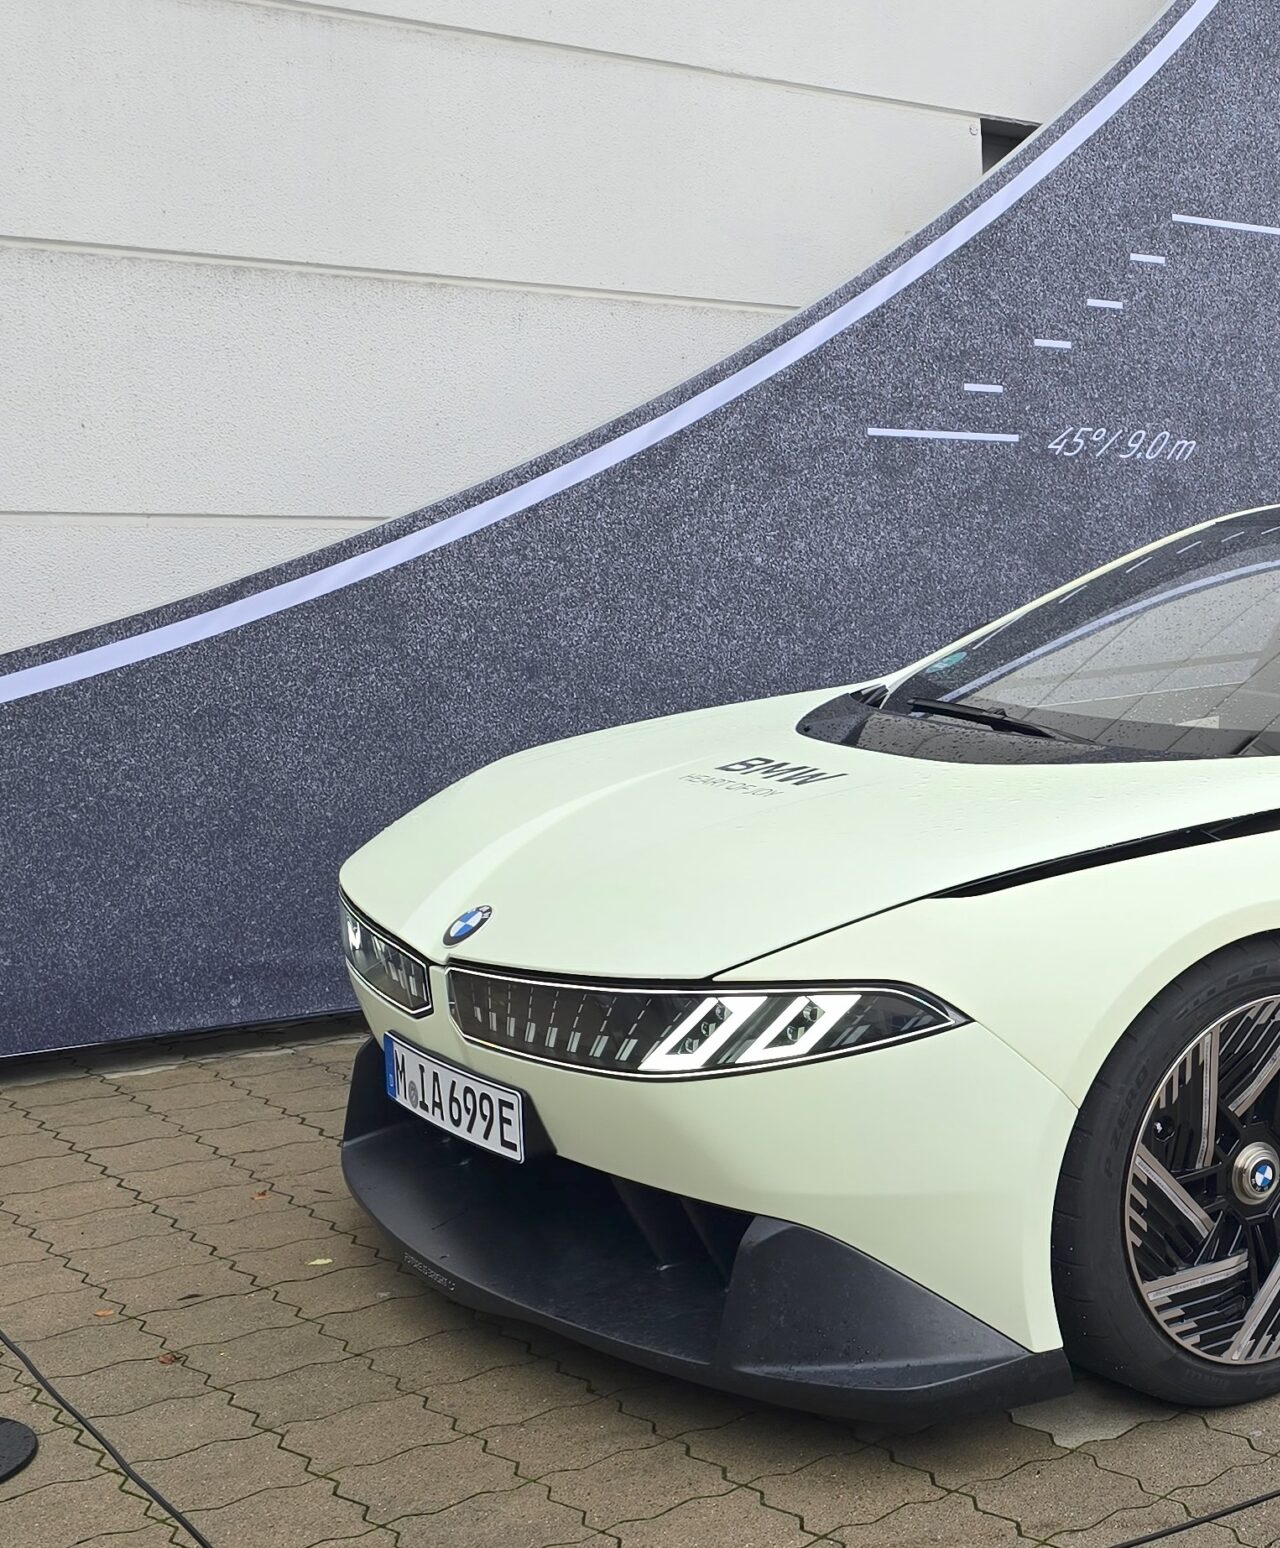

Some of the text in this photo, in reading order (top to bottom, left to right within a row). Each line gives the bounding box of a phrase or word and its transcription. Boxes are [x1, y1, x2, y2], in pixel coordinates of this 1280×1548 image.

[1166, 438, 1197, 461] m
[714, 756, 849, 786] BMW
[393, 1049, 408, 1102] M
